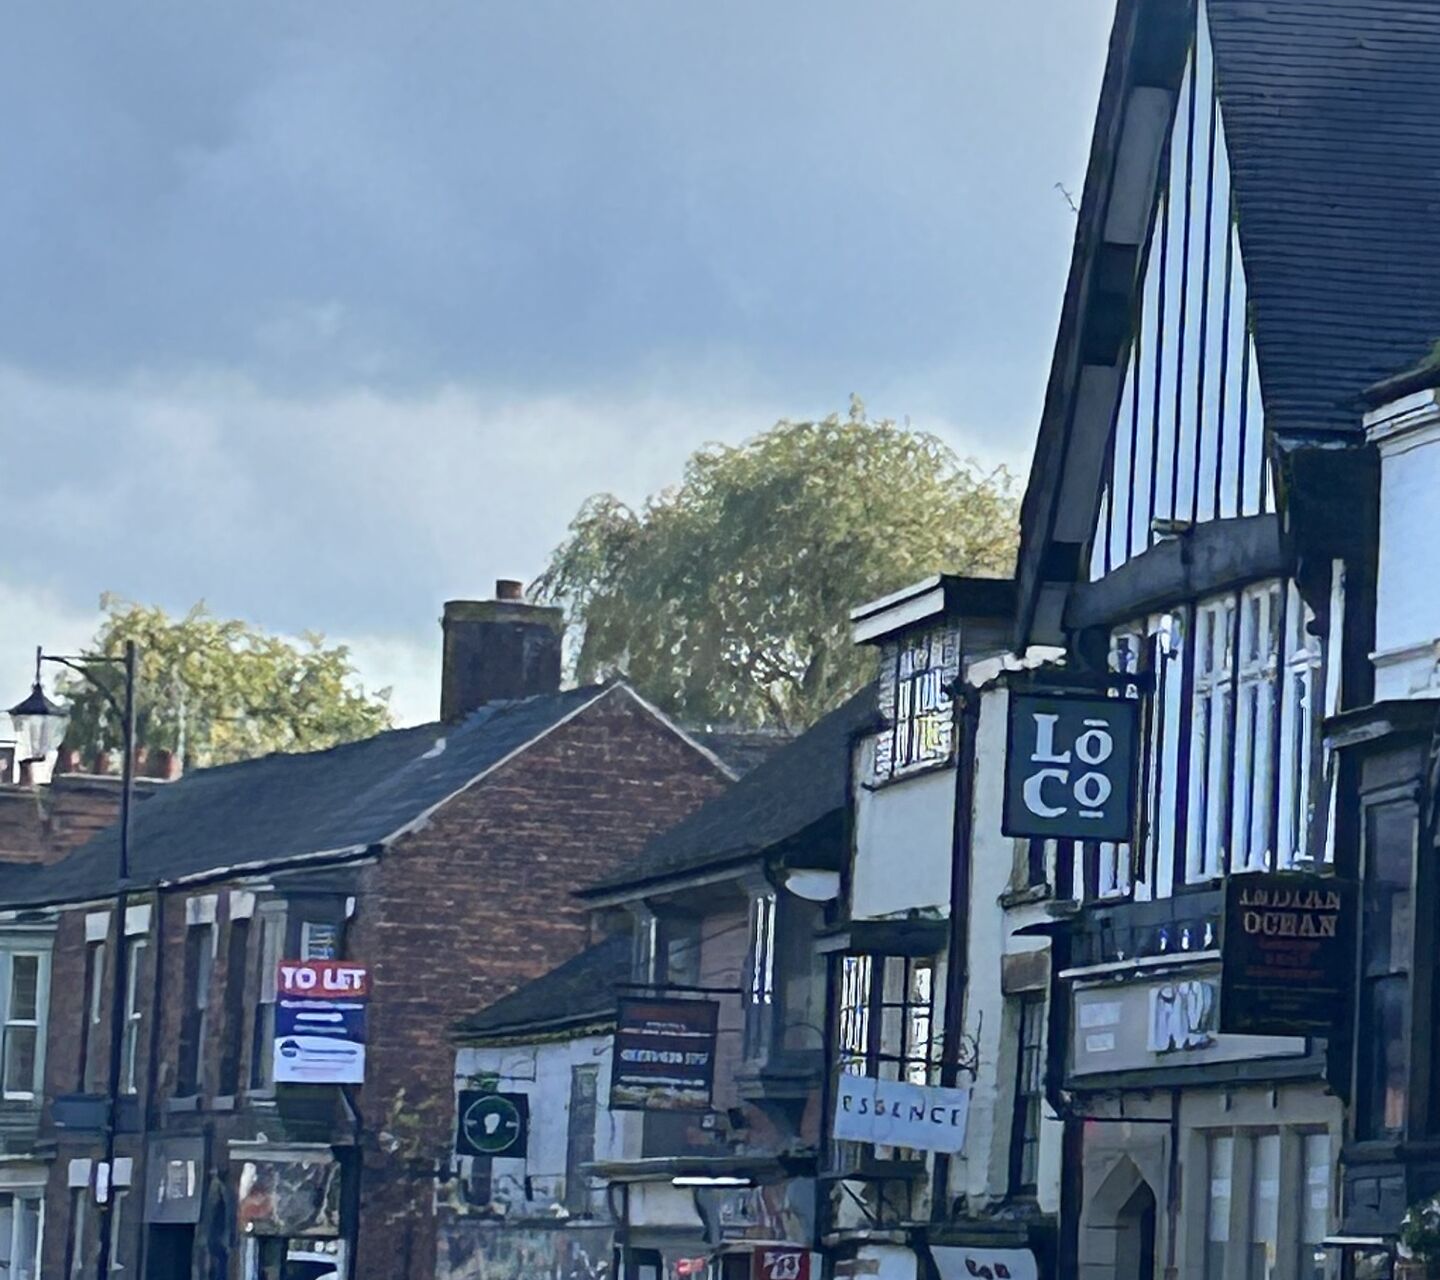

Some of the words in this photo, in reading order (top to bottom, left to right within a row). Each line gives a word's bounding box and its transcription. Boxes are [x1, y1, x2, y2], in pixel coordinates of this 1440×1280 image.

[1239, 888, 1342, 911] INDIAN
[1243, 912, 1339, 937] OCEAN
[280, 966, 318, 990] TO
[322, 967, 367, 991] LET
[842, 1094, 961, 1127] ESSENCE
